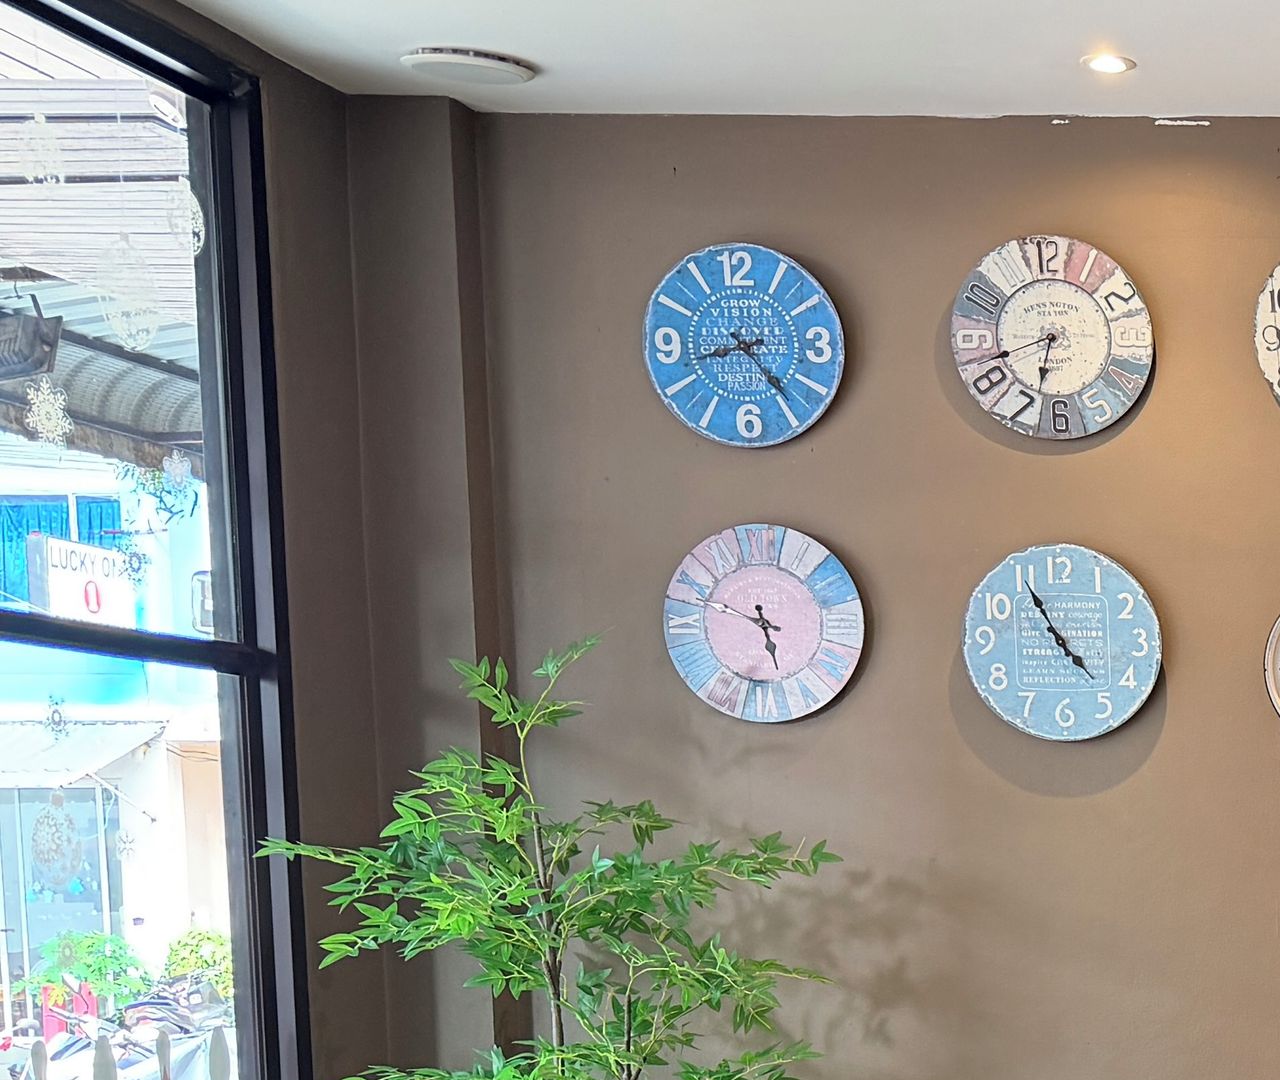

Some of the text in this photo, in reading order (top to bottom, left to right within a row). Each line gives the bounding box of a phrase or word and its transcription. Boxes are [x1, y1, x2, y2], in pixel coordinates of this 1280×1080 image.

[717, 251, 754, 286] 12
[1036, 240, 1058, 273] 12
[721, 299, 760, 307] GROW
[1024, 302, 1080, 314] KENSNGTON
[1104, 282, 1136, 311] 2
[706, 318, 778, 326] CHANGE
[711, 308, 772, 316] VISION
[654, 327, 681, 364] 9
[805, 327, 832, 364] 3
[728, 382, 766, 391] PASSION
[736, 403, 762, 438] 6
[50, 546, 96, 577] LUCKY
[1047, 556, 1072, 584] 12
[986, 593, 1011, 620] 10
[1117, 593, 1134, 619] 2
[975, 626, 995, 656] 9
[1131, 628, 1149, 657] 3
[989, 663, 1008, 690] 8
[1118, 664, 1137, 689] 4
[1018, 692, 1036, 717] 7
[1055, 698, 1075, 728] 6
[1095, 693, 1113, 719] 5
